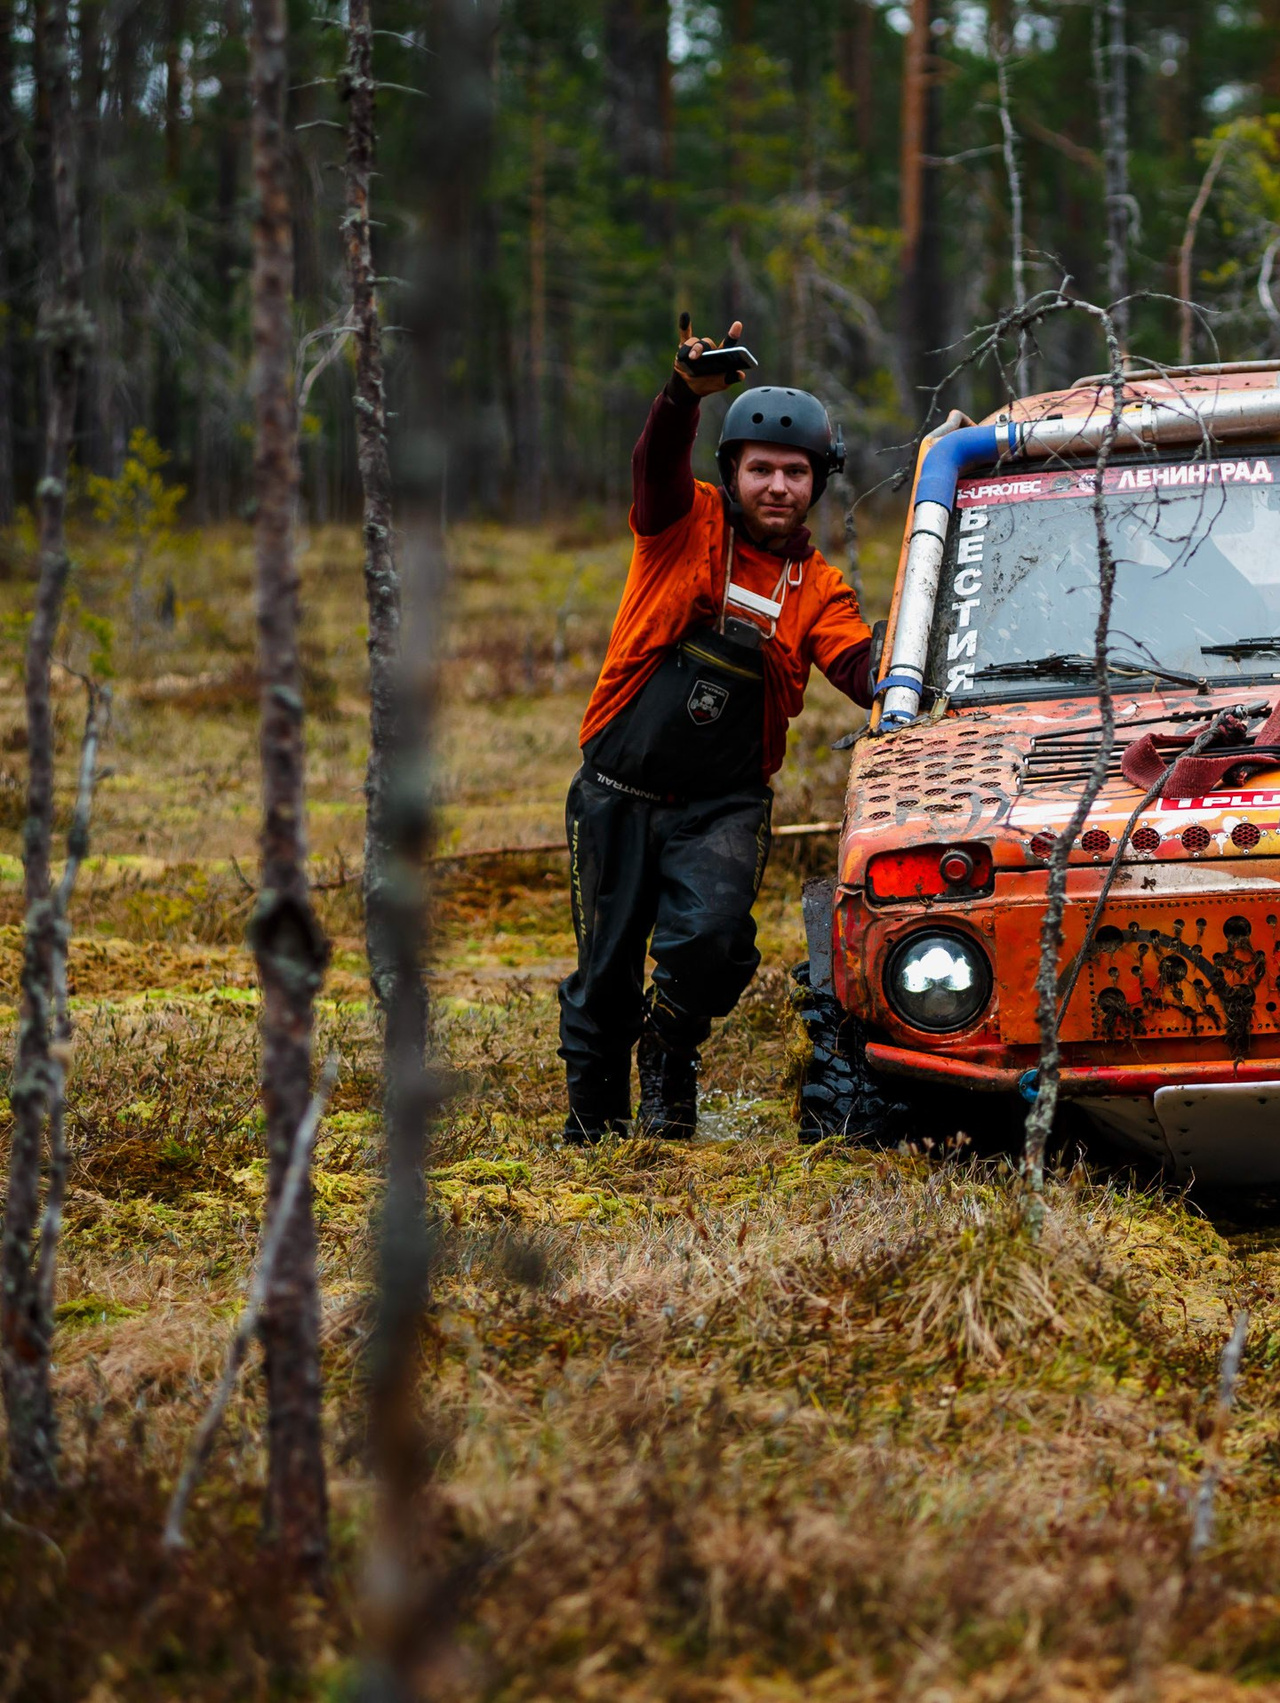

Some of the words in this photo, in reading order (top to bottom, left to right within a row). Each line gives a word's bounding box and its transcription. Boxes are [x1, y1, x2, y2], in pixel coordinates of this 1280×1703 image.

[1117, 460, 1273, 489] ЛЕНИНГРАД
[945, 504, 989, 692] БЕСТИЯ
[597, 772, 661, 801] FINNTRAIL
